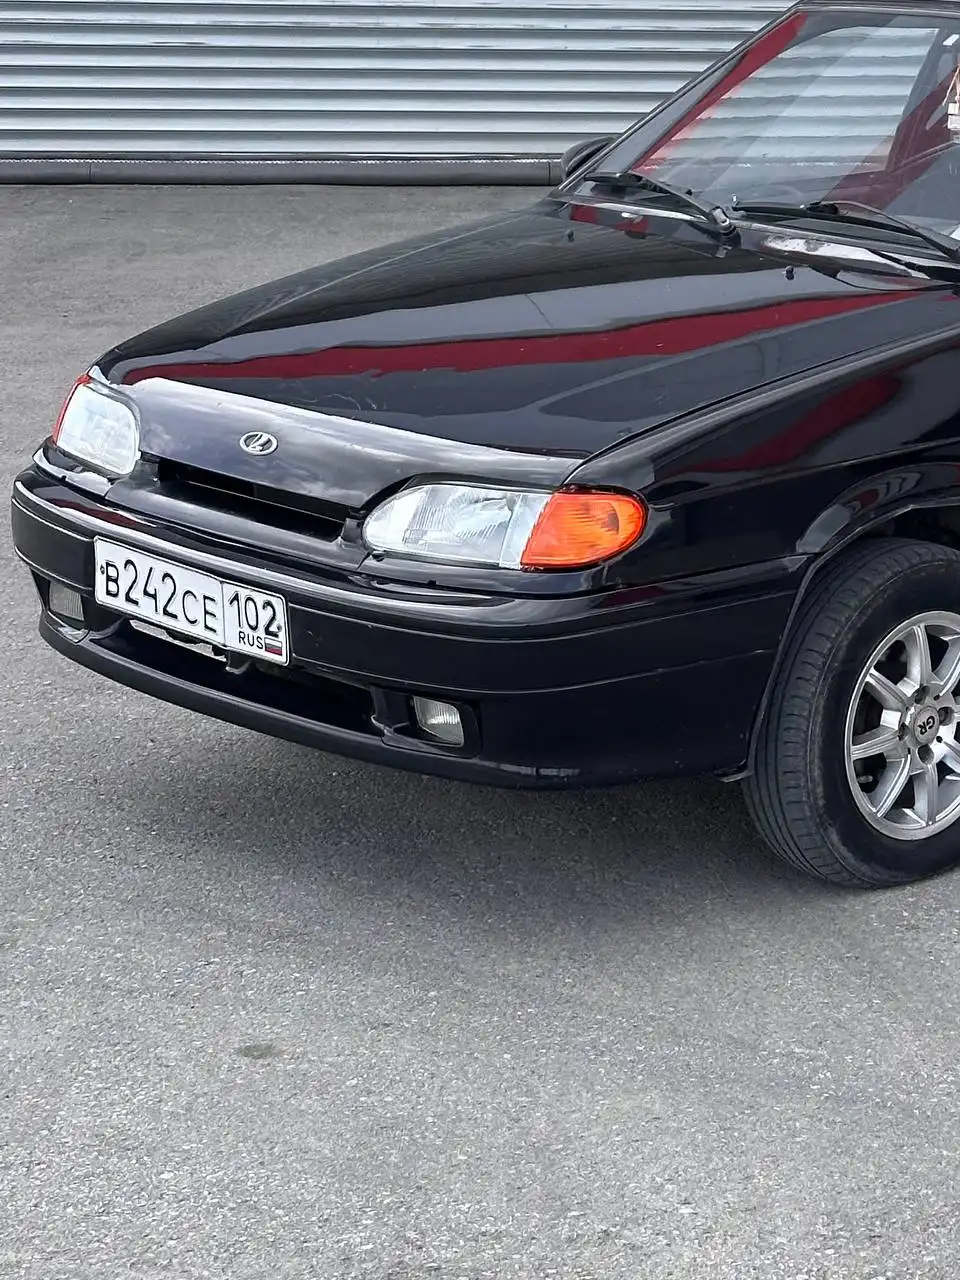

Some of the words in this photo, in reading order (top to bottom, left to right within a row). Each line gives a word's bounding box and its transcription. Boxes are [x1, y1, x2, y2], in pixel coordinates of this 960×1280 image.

[229, 591, 280, 638] 102
[238, 630, 264, 650] RUS
[918, 715, 935, 735] GR
